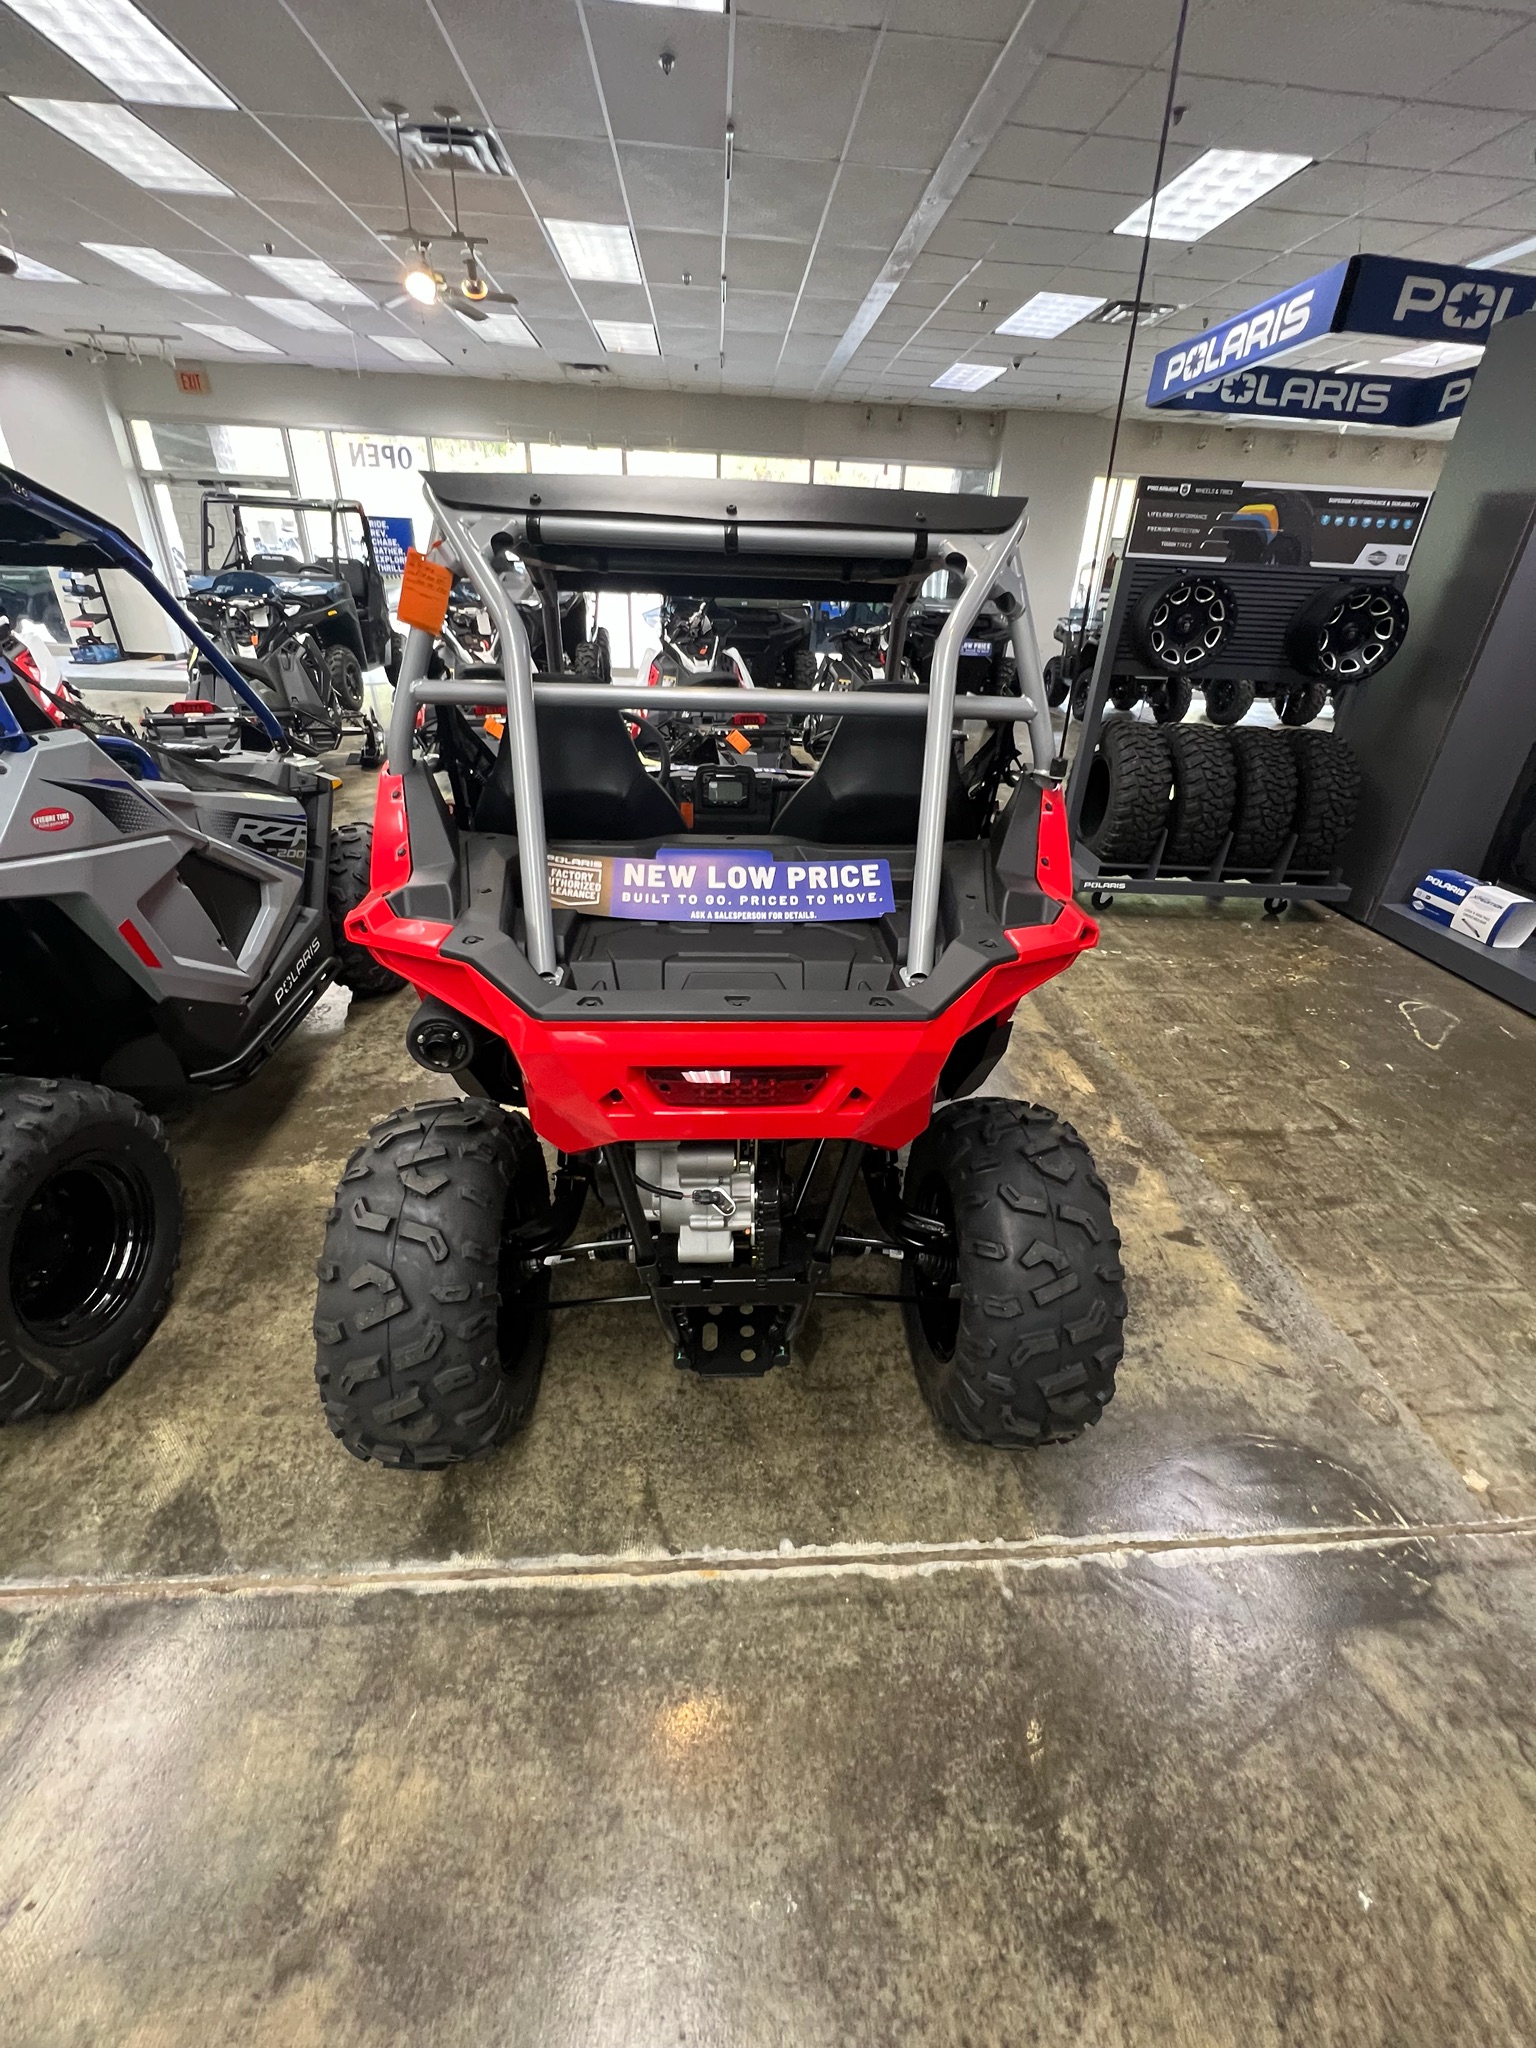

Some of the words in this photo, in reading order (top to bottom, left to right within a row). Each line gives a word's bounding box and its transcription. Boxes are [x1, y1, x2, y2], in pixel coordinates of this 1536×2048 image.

[1163, 289, 1316, 391] POLARIS
[180, 373, 202, 391] EXIT
[276, 848, 305, 858] 200
[547, 854, 602, 868] POLARIS
[551, 868, 594, 882] FACTORY
[623, 863, 697, 889] NEW
[707, 866, 776, 890] LOW
[787, 864, 881, 890] PRICE
[548, 876, 602, 892] UTHORIZED
[1083, 881, 1126, 889] POLARIS
[1425, 875, 1467, 897] POLARIS
[549, 886, 596, 900] LEARANCE
[621, 891, 671, 905] BUILT
[678, 893, 698, 905] TO
[705, 895, 732, 906] GO.
[739, 895, 799, 906] PRICED
[806, 894, 826, 905] TO
[833, 891, 884, 905] MOVE.
[690, 911, 706, 919] ASK
[707, 911, 713, 919] A
[713, 911, 767, 920] SALESPERSON
[768, 911, 783, 920] FOR
[784, 911, 817, 919] DETAILS.
[274, 936, 321, 1006] POLARIS
